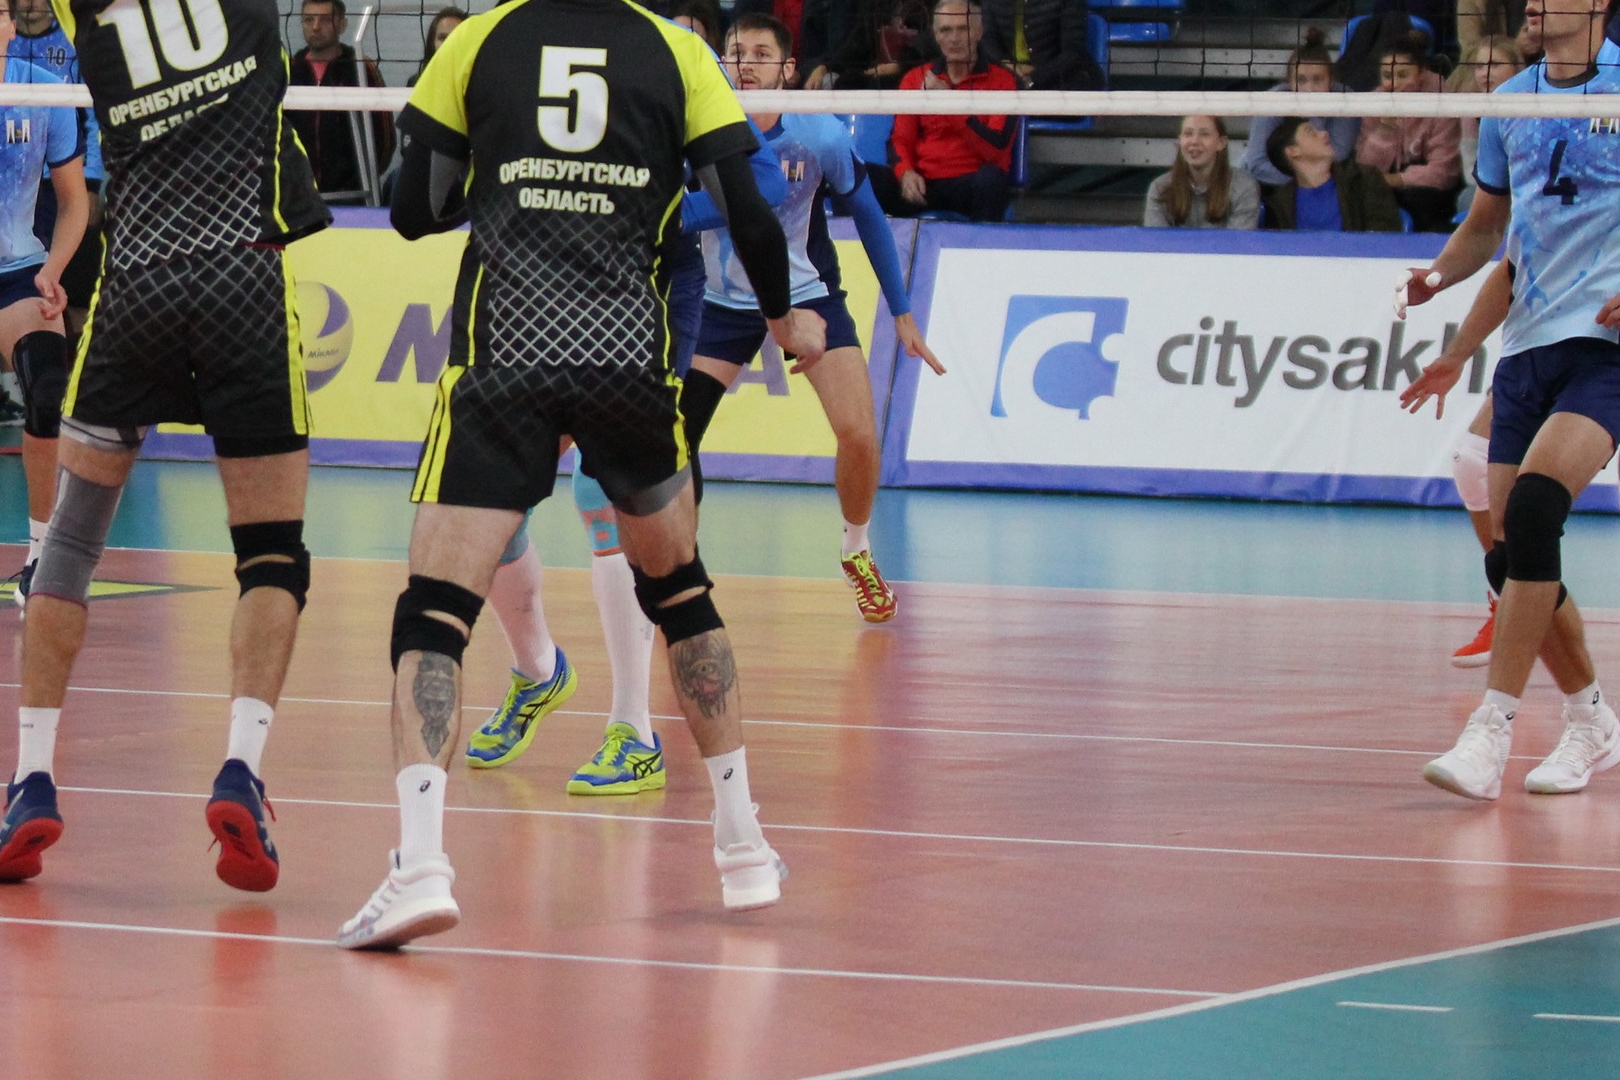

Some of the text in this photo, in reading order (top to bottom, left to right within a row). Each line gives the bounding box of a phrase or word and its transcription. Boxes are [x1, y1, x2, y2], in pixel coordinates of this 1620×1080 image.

[47, 46, 67, 66] 10
[109, 55, 258, 128] ОРЕНБУРГСКАЯ
[537, 45, 609, 153] 5
[499, 157, 651, 188] ОРЕНБУРГСКАЯ
[1542, 139, 1579, 206] 4
[518, 187, 615, 215] ОБЛАСТЬ
